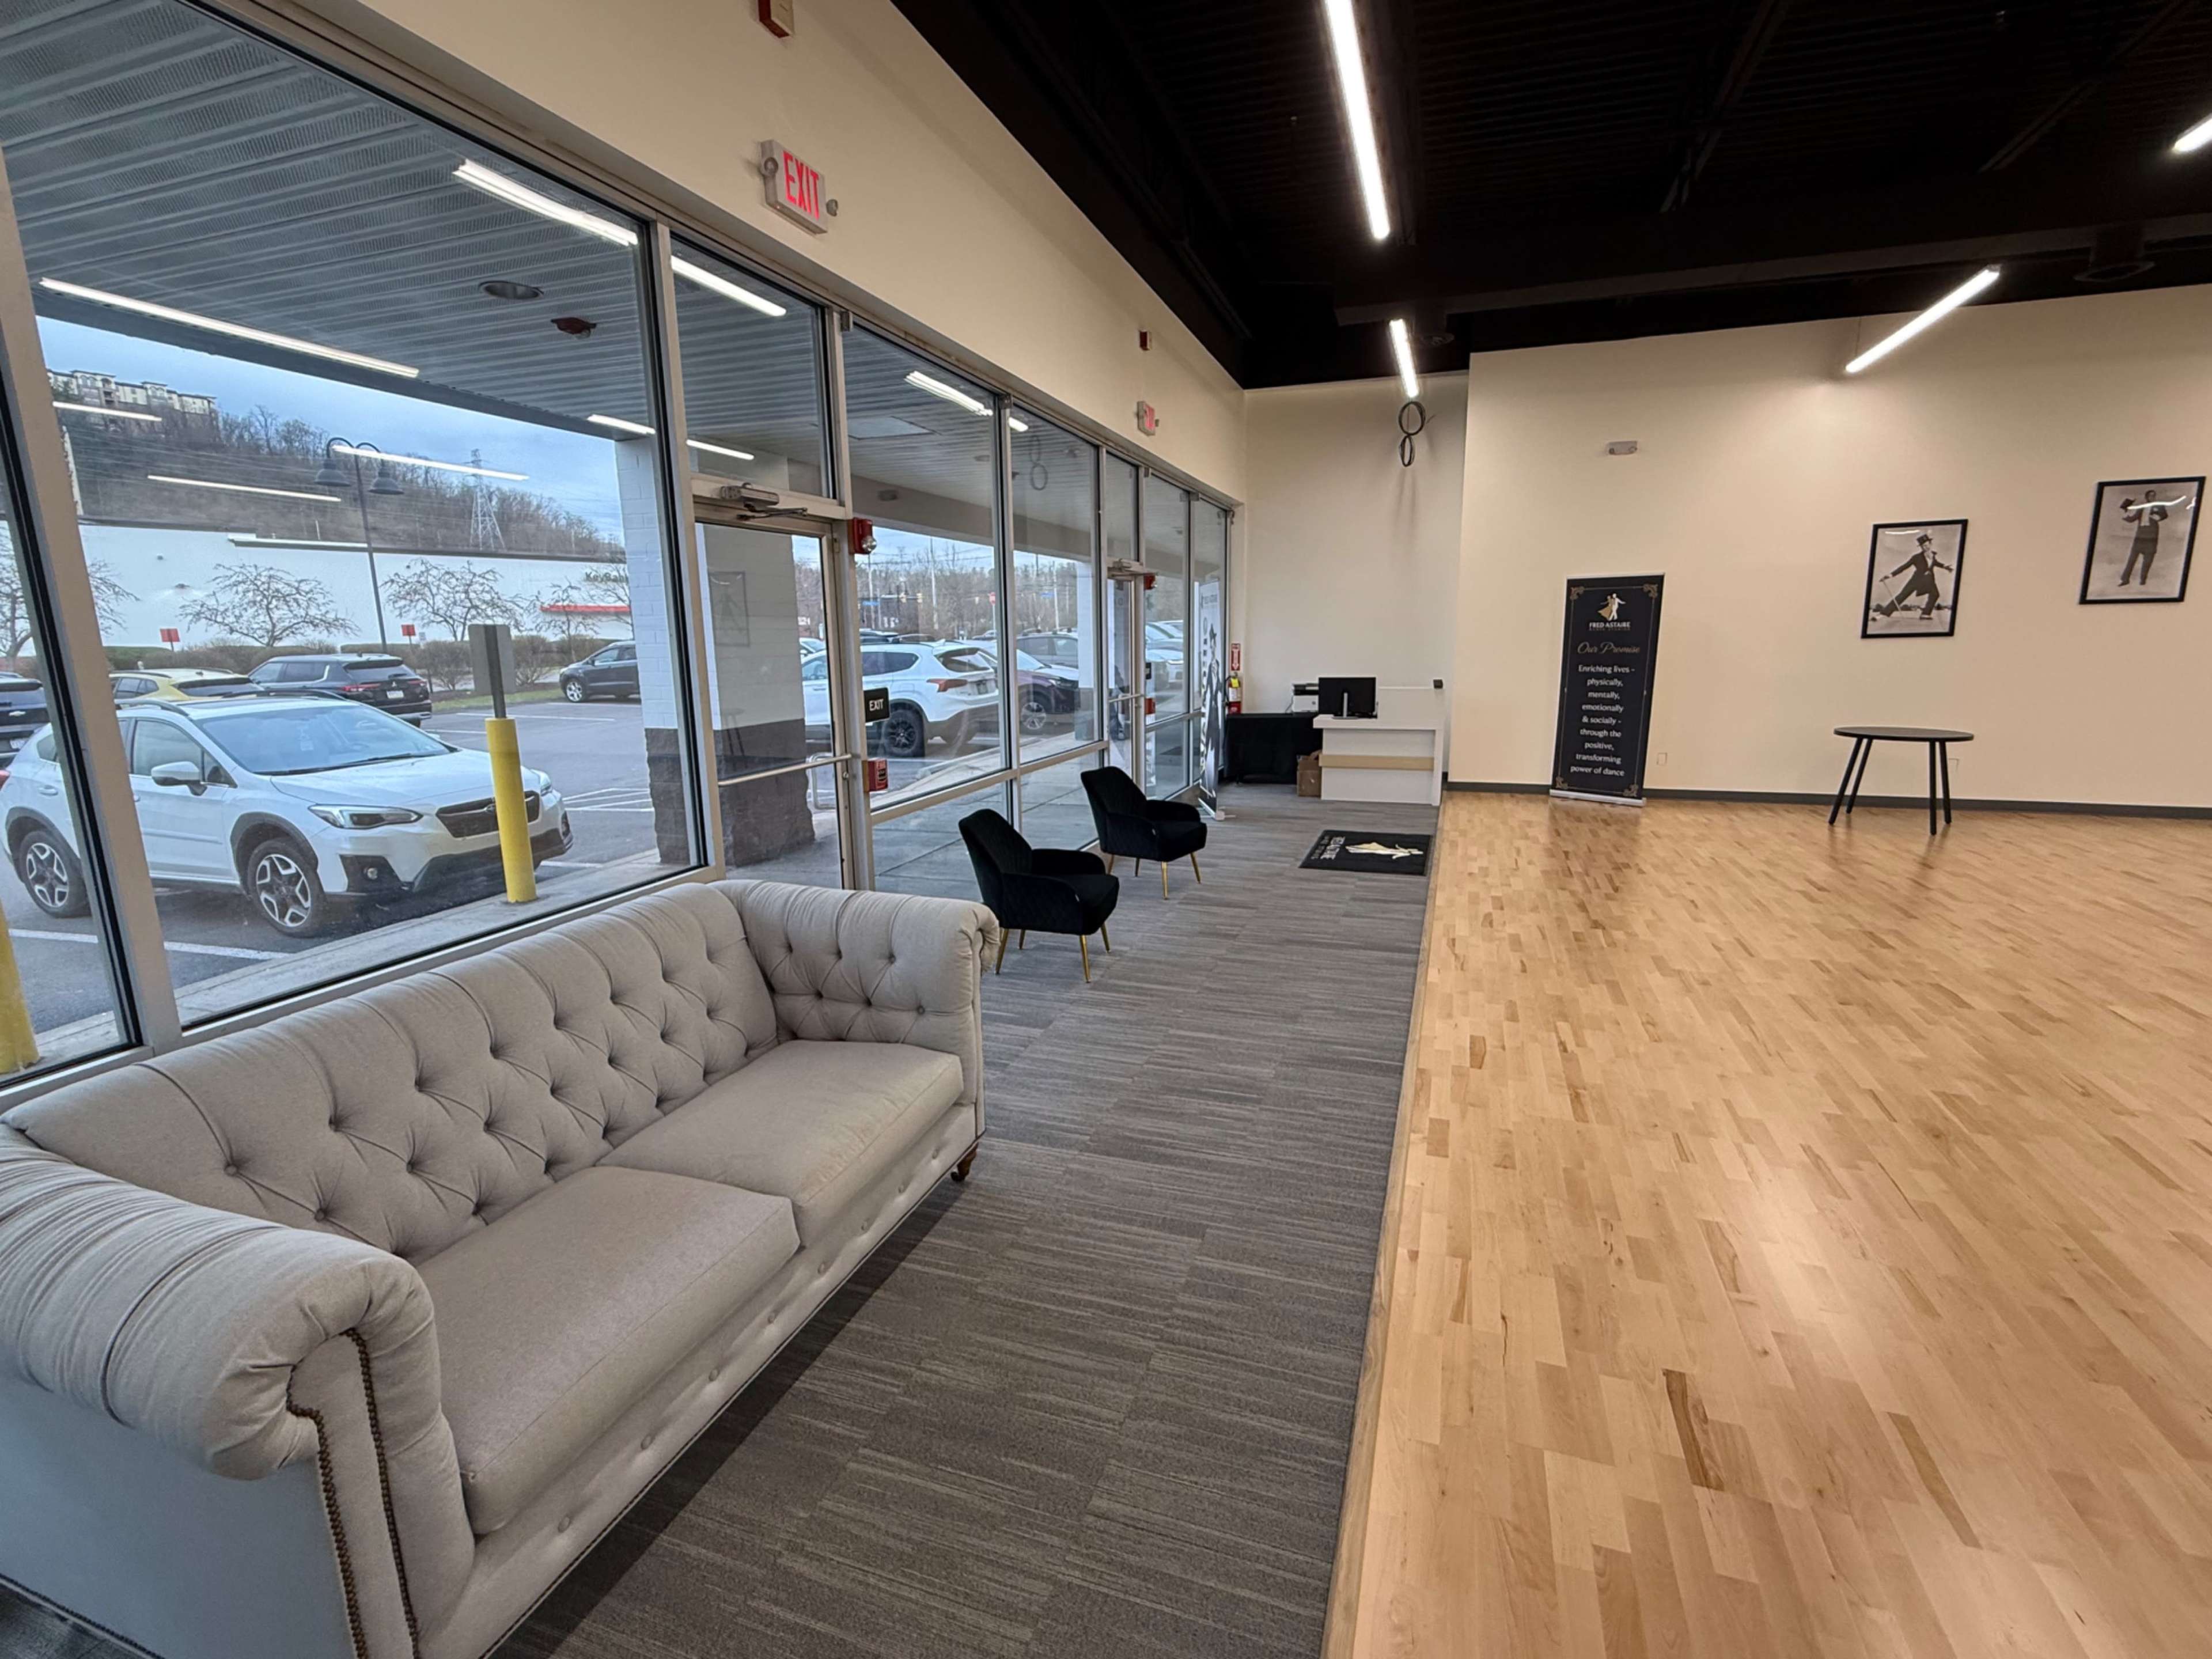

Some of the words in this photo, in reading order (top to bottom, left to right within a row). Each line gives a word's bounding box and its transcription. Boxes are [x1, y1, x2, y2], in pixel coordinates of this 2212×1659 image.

[783, 150, 819, 220] EXIT
[1577, 641, 1598, 654] Our
[1599, 641, 1641, 654] Promise
[1578, 664, 1612, 674] Enriching
[1587, 677, 1623, 687] physically,
[1588, 691, 1620, 700] mentally,
[869, 698, 884, 711] EXIT
[1582, 704, 1624, 713] emotionally
[1590, 717, 1616, 725] socially
[1580, 728, 1608, 737] through
[1585, 742, 1614, 751] positive,
[1576, 753, 1622, 764] transforming
[1603, 768, 1625, 777] dance
